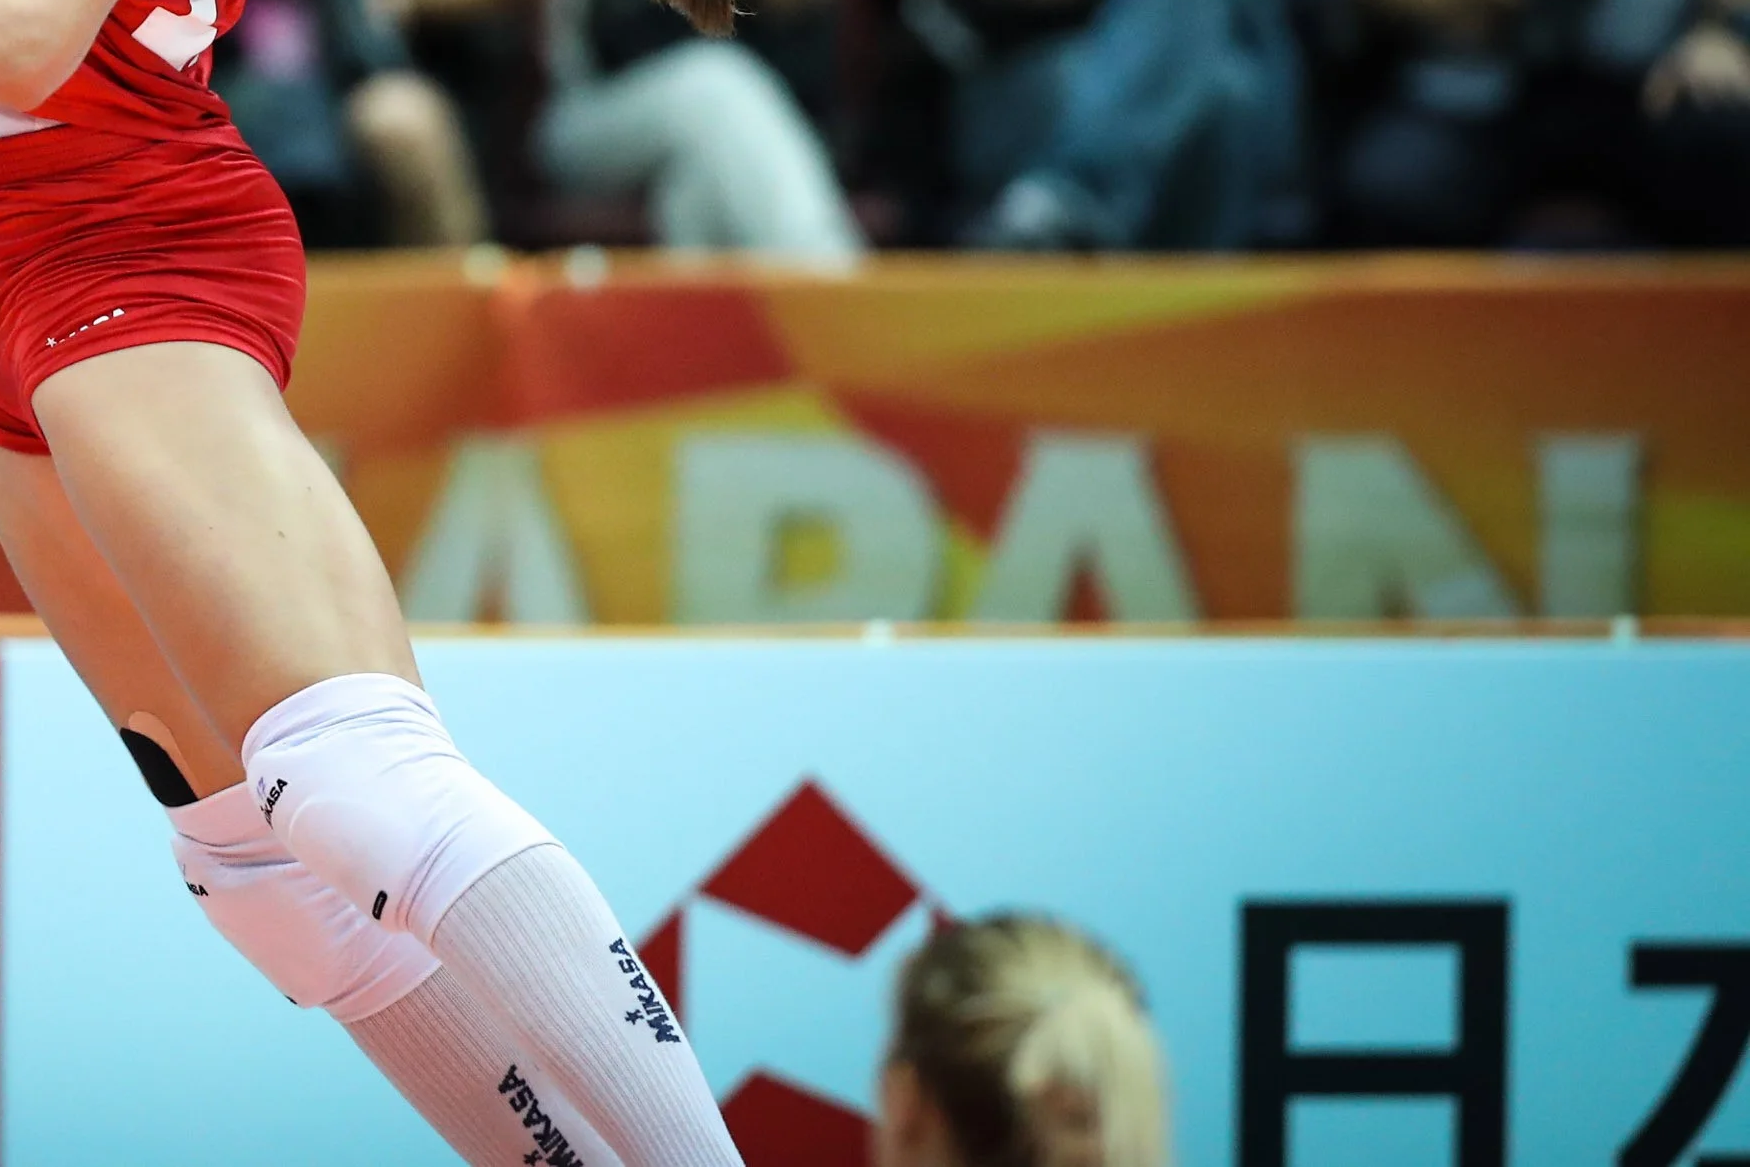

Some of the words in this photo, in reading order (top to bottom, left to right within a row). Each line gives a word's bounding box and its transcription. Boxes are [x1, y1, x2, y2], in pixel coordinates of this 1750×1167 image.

[321, 431, 1643, 624] APAN
[609, 937, 681, 1043] MIKASA
[498, 1064, 584, 1167] MIKASA
